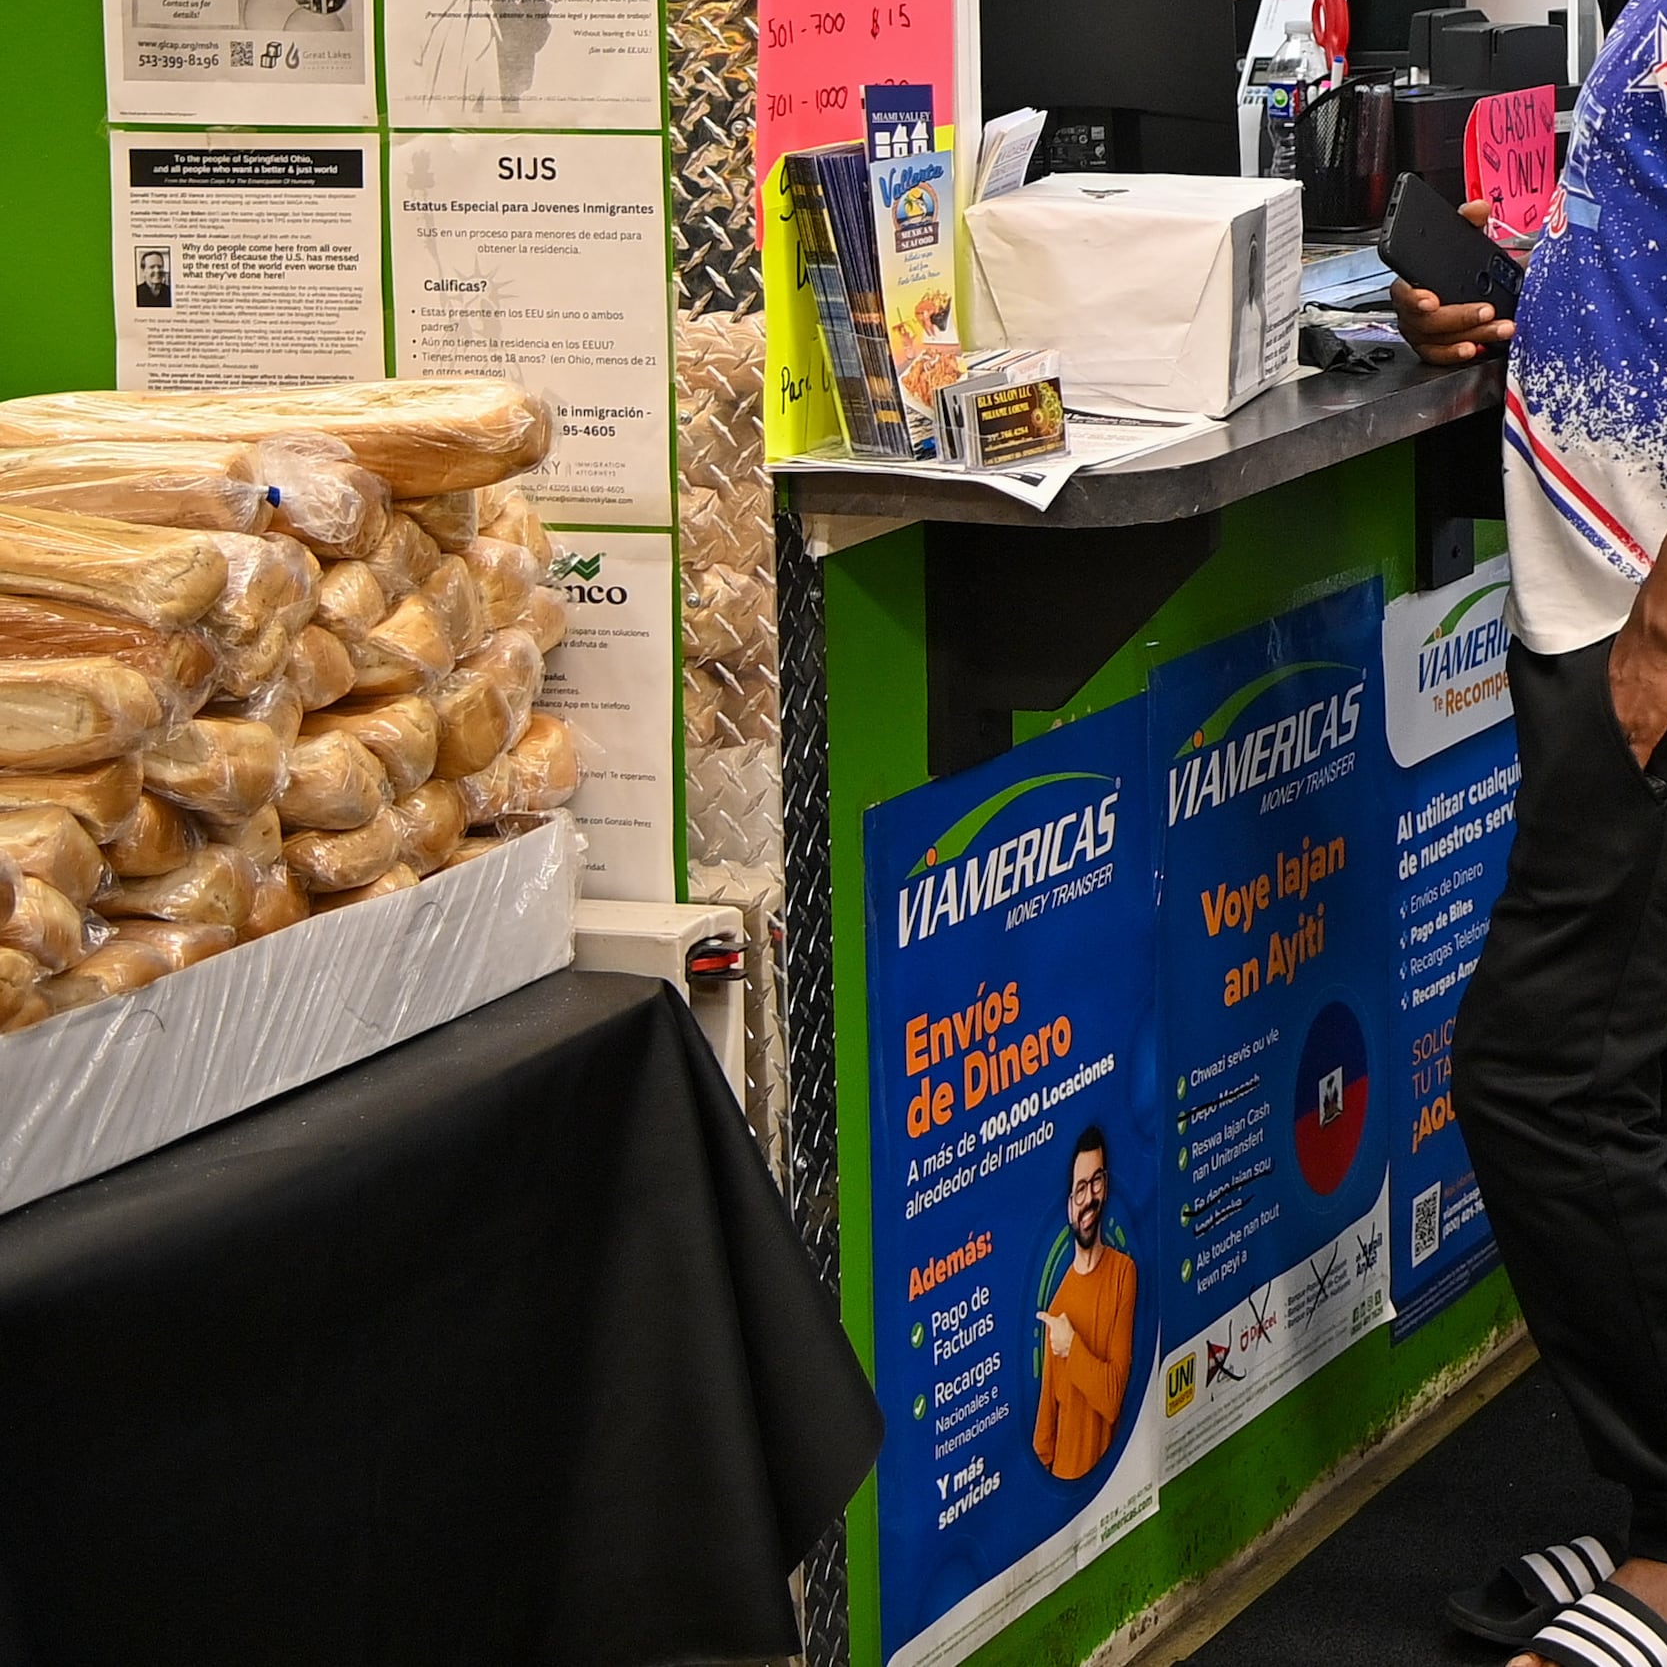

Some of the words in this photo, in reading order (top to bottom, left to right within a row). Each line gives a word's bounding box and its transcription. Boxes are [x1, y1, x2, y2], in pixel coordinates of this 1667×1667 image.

[768, 12, 845, 47] 501-700
[888, 4, 910, 27] 15
[139, 54, 219, 69] 513-399-8196
[767, 86, 848, 121] 701-1,000
[872, 113, 898, 122] MIAMI
[900, 111, 930, 122] VALLEY
[174, 154, 184, 163] To
[186, 154, 199, 163] the
[201, 155, 230, 166] people
[232, 154, 240, 163] of
[243, 154, 288, 166] Springfield
[290, 154, 313, 165] Ohio,
[497, 158, 557, 181] SIJS
[879, 163, 944, 208] Vallarta
[1507, 145, 1546, 198] ONLY
[403, 200, 447, 213] Estatus
[451, 200, 499, 215] Especial
[501, 203, 528, 215] para
[531, 202, 579, 214] Jovenes
[583, 202, 654, 217] Inmigrantes
[901, 225, 933, 238] MEXICAN
[901, 235, 934, 250] SEAFOOD
[424, 278, 487, 293] Calificas?
[1168, 682, 1364, 827] VIAMERICAS
[1260, 781, 1303, 815] MONEY
[1305, 752, 1355, 795] TRANSFER
[1397, 813, 1413, 845] Al
[1417, 785, 1466, 835] utilizar
[898, 792, 1118, 949] VIAMERICAS
[1399, 851, 1418, 880] de
[1421, 820, 1482, 869] nuestros
[1005, 890, 1049, 932] MONEY
[1051, 863, 1113, 911] TRANSFER
[1201, 871, 1270, 936] Voye
[1277, 834, 1345, 901] lajan
[1410, 917, 1433, 946] Pago
[1435, 912, 1448, 930] de
[1450, 897, 1473, 925] Biles
[1223, 964, 1259, 1007] an
[1266, 903, 1325, 986] Ayiti
[906, 981, 1019, 1078] Envíos
[906, 1078, 953, 1138] de
[964, 1014, 1072, 1111] Dinero
[907, 1160, 919, 1186] A
[923, 1144, 953, 1177] más
[956, 1131, 976, 1156] de
[979, 1093, 1039, 1146] 100,000
[1042, 1052, 1114, 1109] Locaciones
[908, 1231, 992, 1302] Además:
[932, 1298, 968, 1341] Pago
[972, 1285, 990, 1315] de
[934, 1314, 994, 1366] Facturas
[934, 1350, 1001, 1408] Recargas
[1169, 1357, 1194, 1398] UNI
[936, 1475, 949, 1501] Y
[953, 1456, 984, 1492] más
[938, 1469, 1000, 1531] servicios
